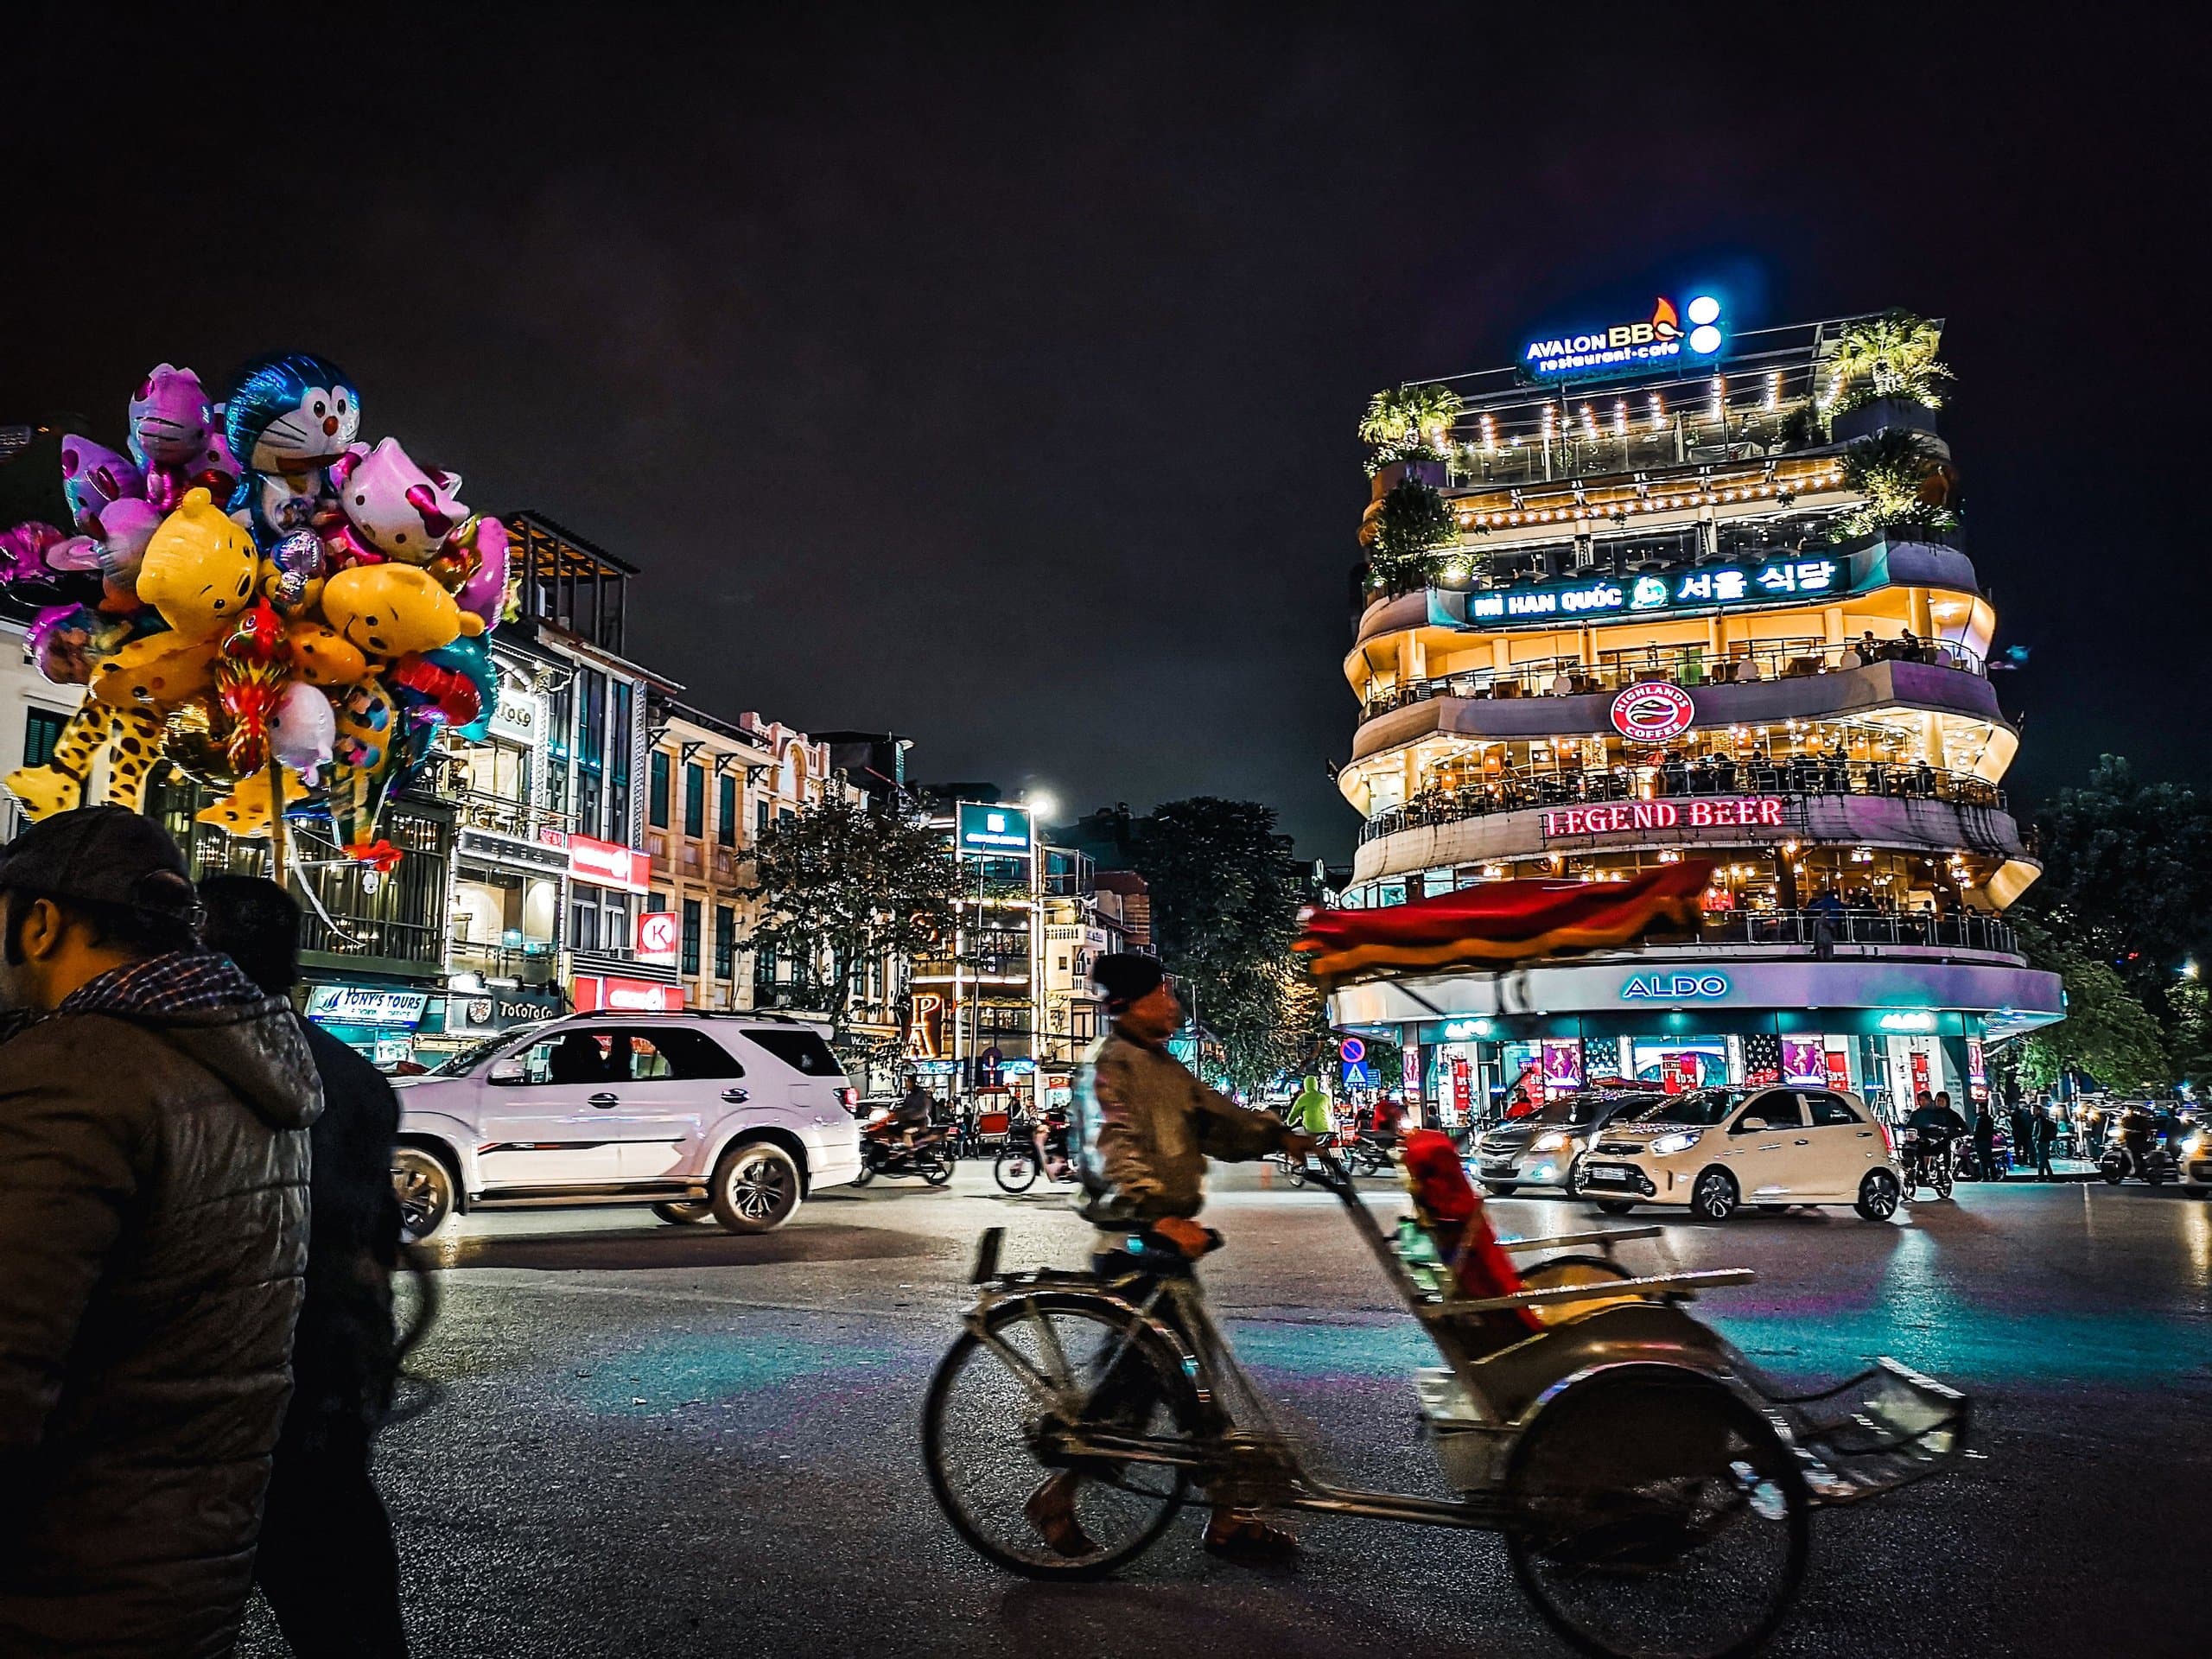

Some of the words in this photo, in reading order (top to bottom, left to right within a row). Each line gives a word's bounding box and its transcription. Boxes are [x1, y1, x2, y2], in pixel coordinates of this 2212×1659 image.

[1527, 334, 1606, 359] AVALON
[1677, 570, 1748, 599] 서울
[1757, 561, 1836, 592] 식당
[1615, 686, 1689, 713] HIGHLANDS
[1625, 721, 1682, 739] COFFEE
[1548, 804, 1675, 836] LEGEND
[1689, 799, 1783, 827] BEER
[1623, 976, 1726, 997] ALDO
[344, 991, 385, 1007] TONY'S
[387, 995, 423, 1010] TOURS
